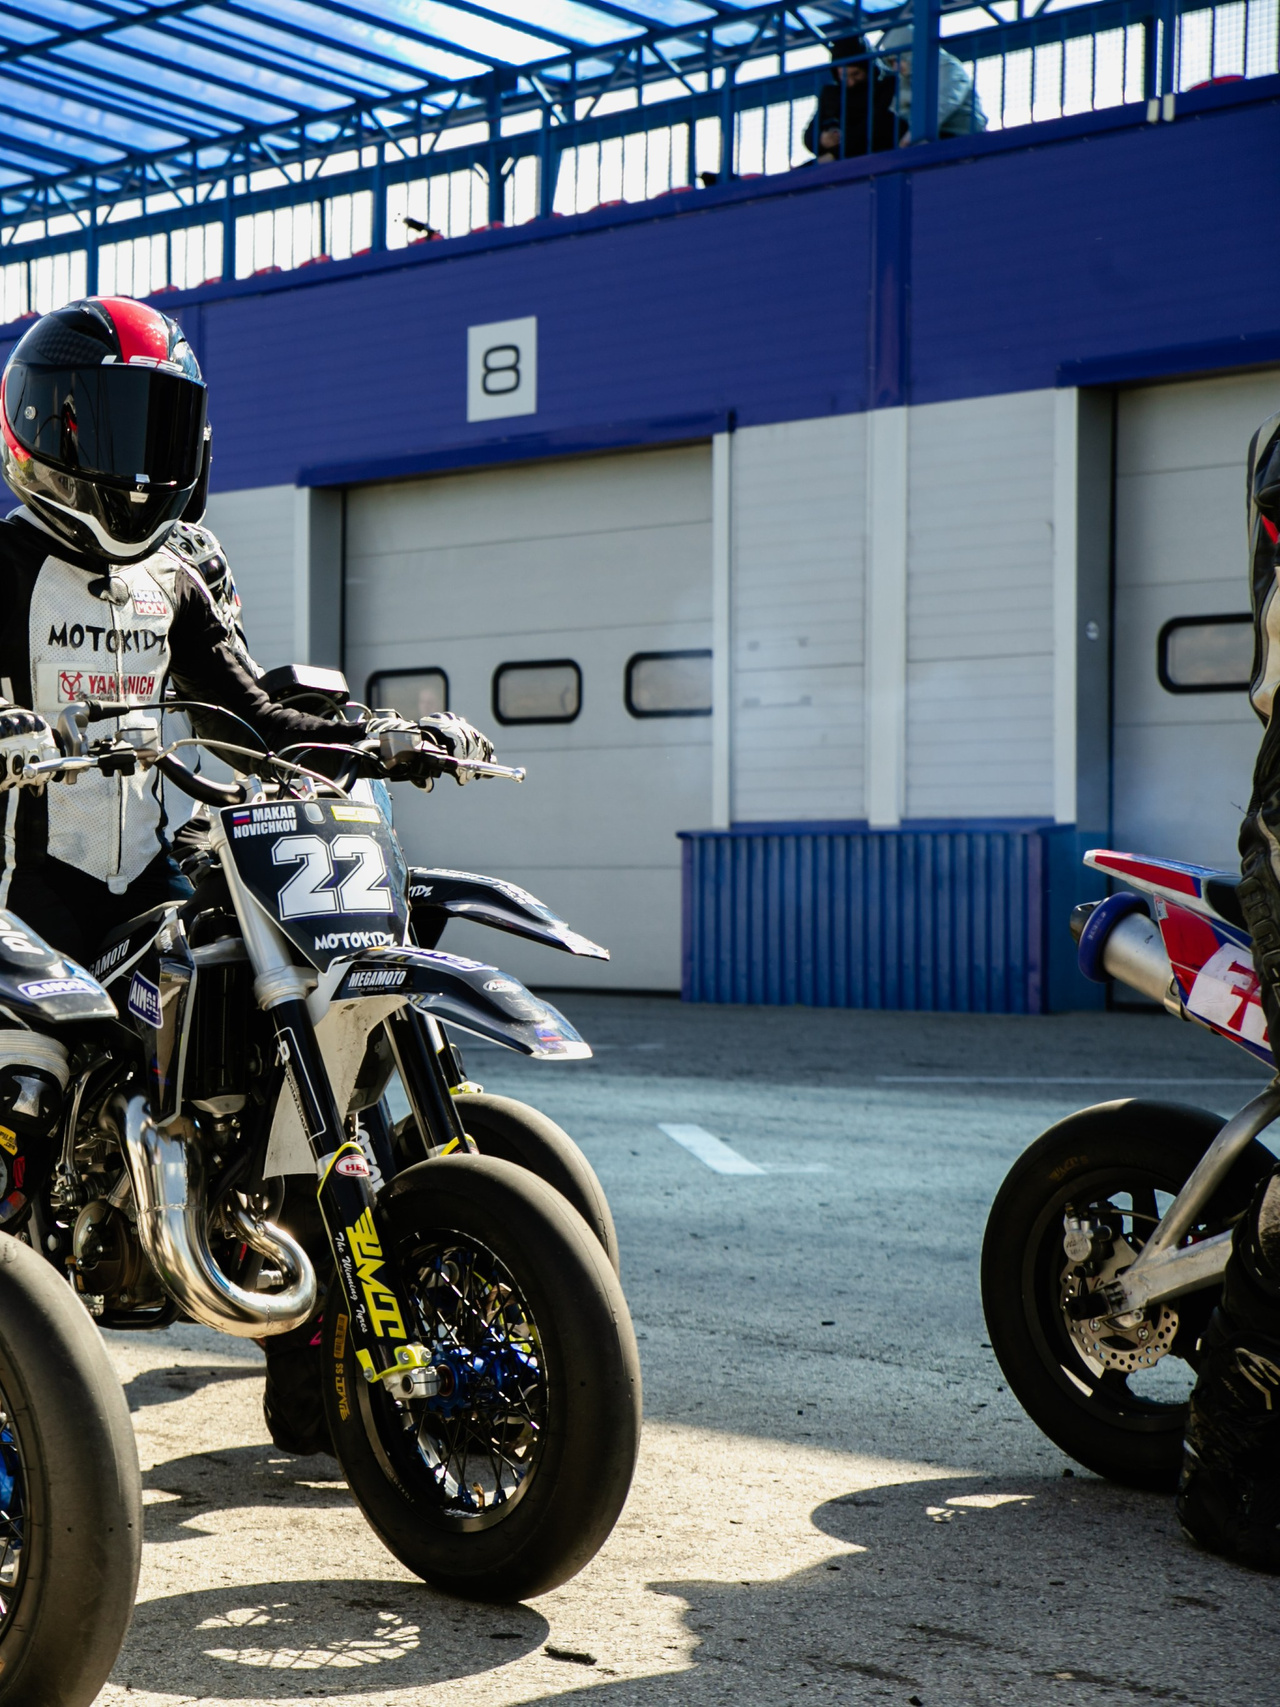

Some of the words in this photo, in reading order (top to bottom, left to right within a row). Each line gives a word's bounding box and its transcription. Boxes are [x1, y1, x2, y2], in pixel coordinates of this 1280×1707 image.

[101, 355, 183, 372] LS2
[483, 344, 520, 395] 8
[136, 601, 166, 614] MOLY
[47, 622, 167, 656] MOTOKIDZ
[252, 805, 297, 823] MAKAR
[233, 818, 298, 840] NOVICHKOV
[271, 833, 395, 922] 22
[314, 931, 398, 951] MOTOKIDZ
[28, 979, 97, 996] AIMOL
[348, 970, 407, 988] MEGAMOTO
[130, 980, 160, 1018] AIMOL
[334, 1232, 345, 1253] The
[341, 1256, 359, 1302] Winning
[355, 1303, 369, 1334] Tyres
[335, 1363, 344, 1375] SS
